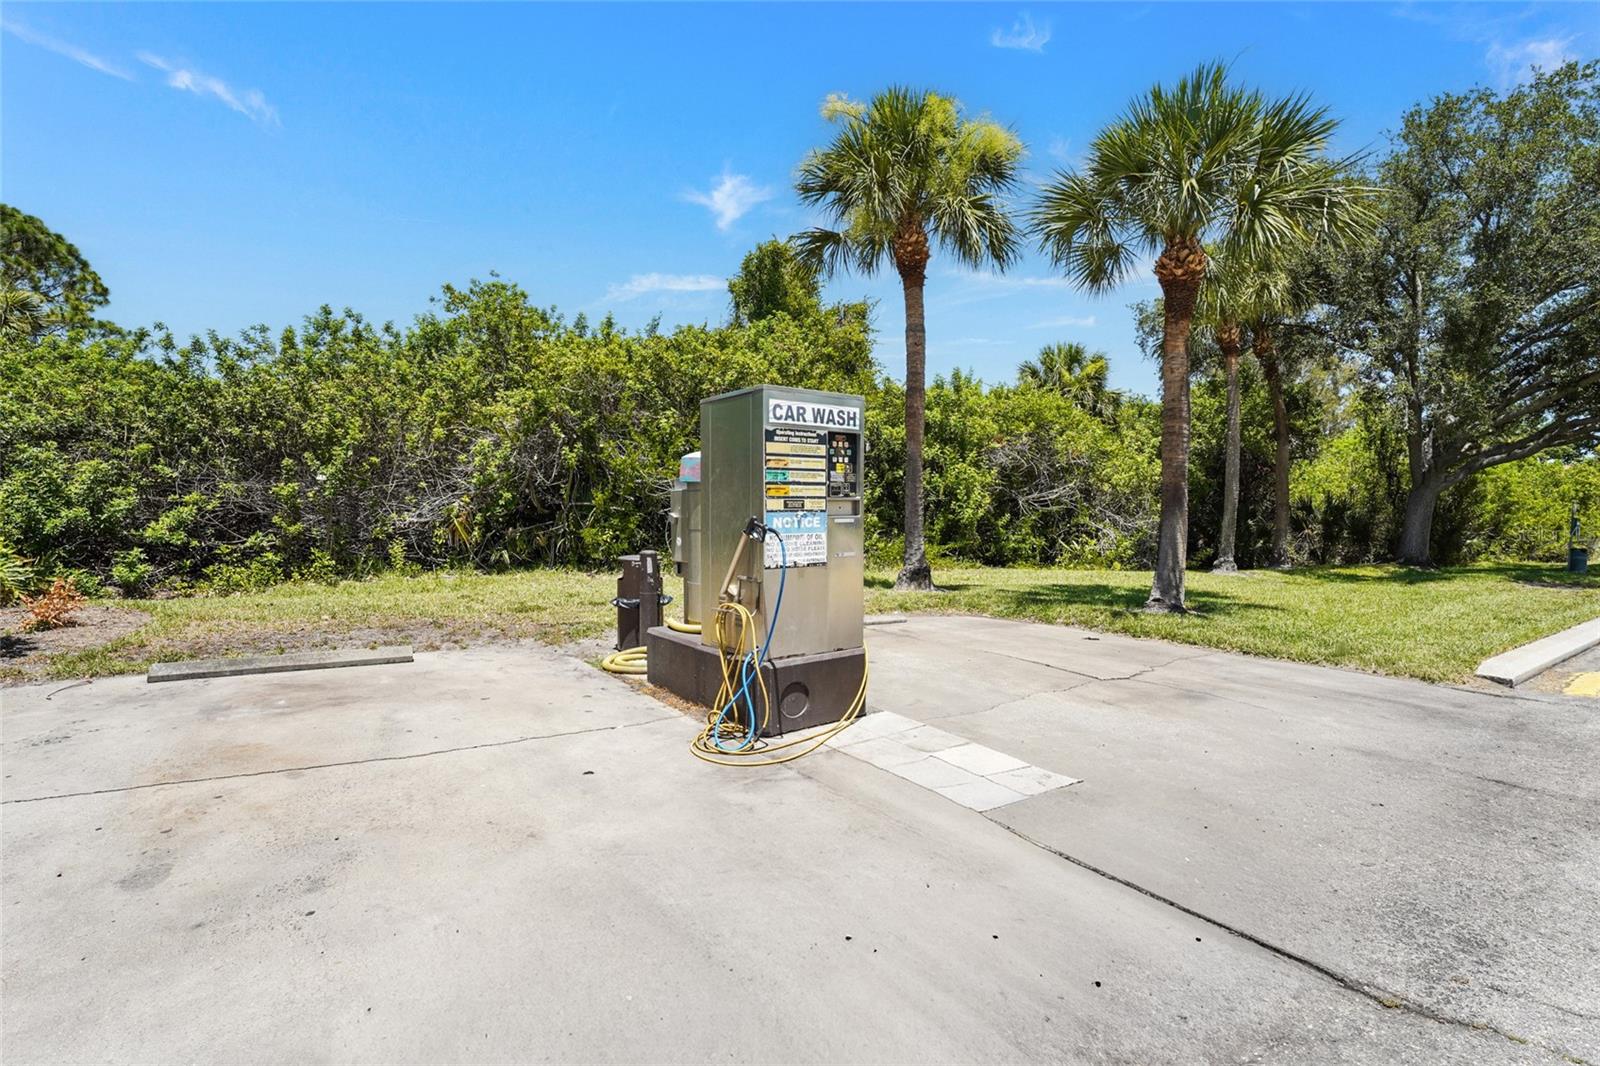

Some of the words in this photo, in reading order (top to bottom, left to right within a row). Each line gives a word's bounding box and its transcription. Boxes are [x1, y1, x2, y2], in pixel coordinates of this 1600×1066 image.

[772, 403, 807, 422] CAR
[812, 407, 857, 427] WASH
[773, 516, 820, 529] NOTICE
